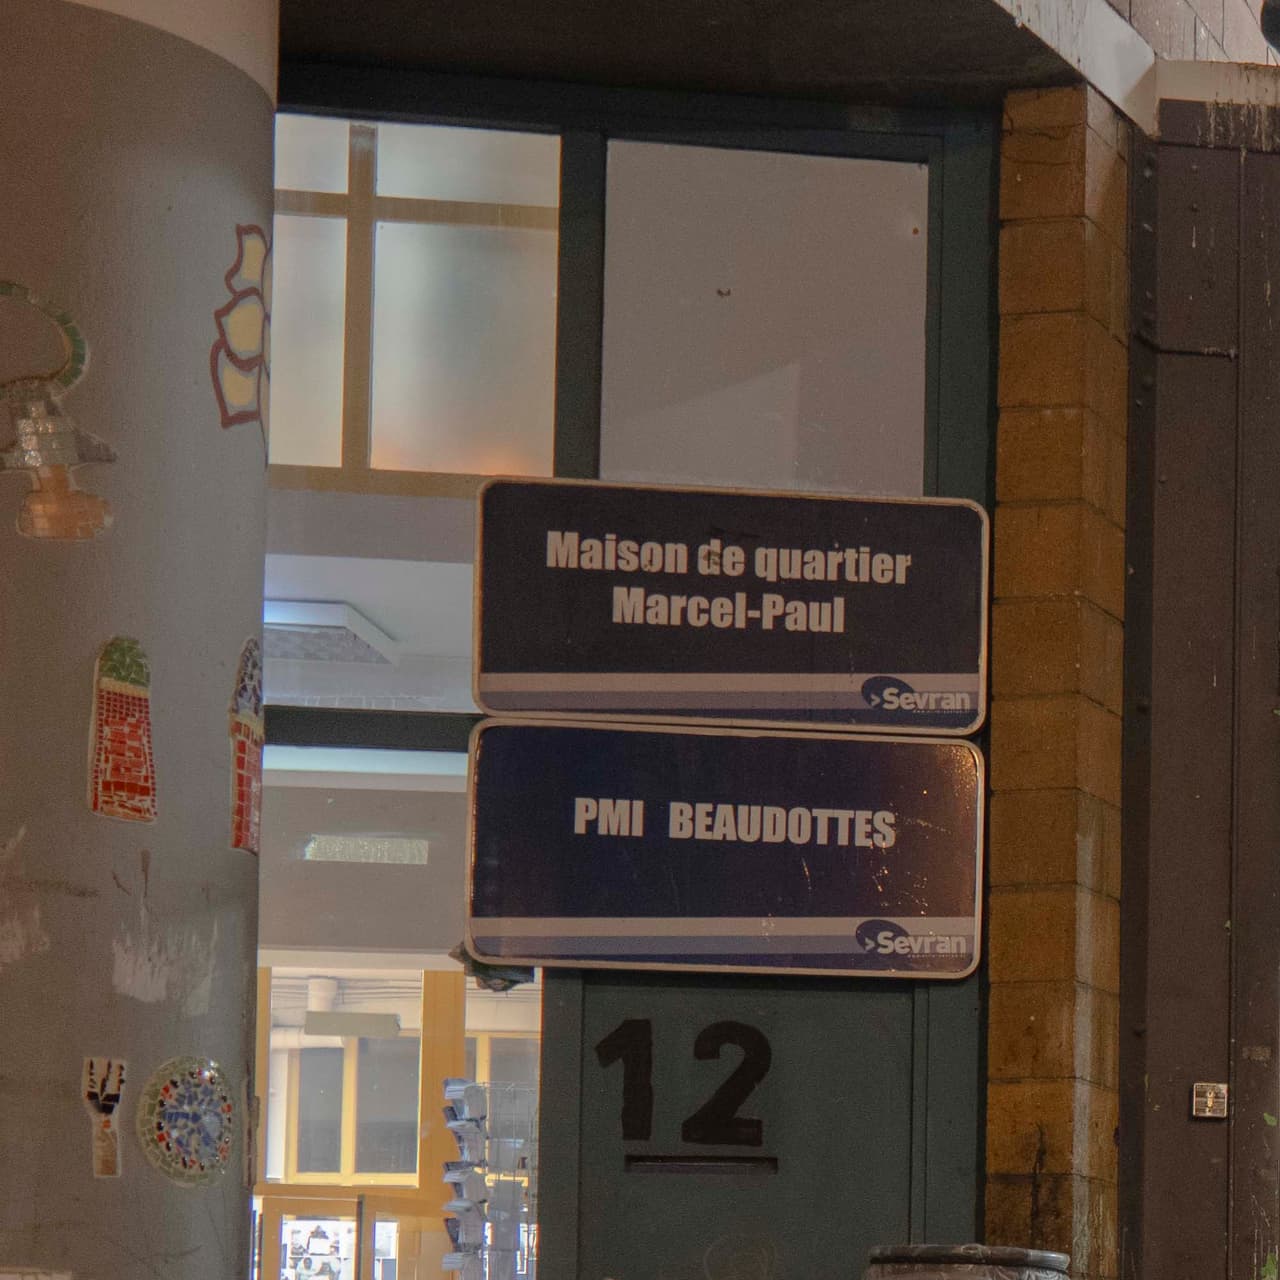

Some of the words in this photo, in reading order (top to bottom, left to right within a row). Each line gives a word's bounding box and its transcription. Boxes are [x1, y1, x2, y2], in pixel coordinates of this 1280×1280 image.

[546, 530, 688, 574] Maison
[697, 538, 746, 577] de
[754, 546, 913, 585] quartier
[612, 586, 845, 633] Marcel-Paul
[882, 686, 971, 711] Sevran
[574, 797, 645, 838] PMI
[668, 802, 897, 848] BEAUDOTTES
[877, 931, 967, 955] Sevran
[595, 1018, 772, 1146] 12
